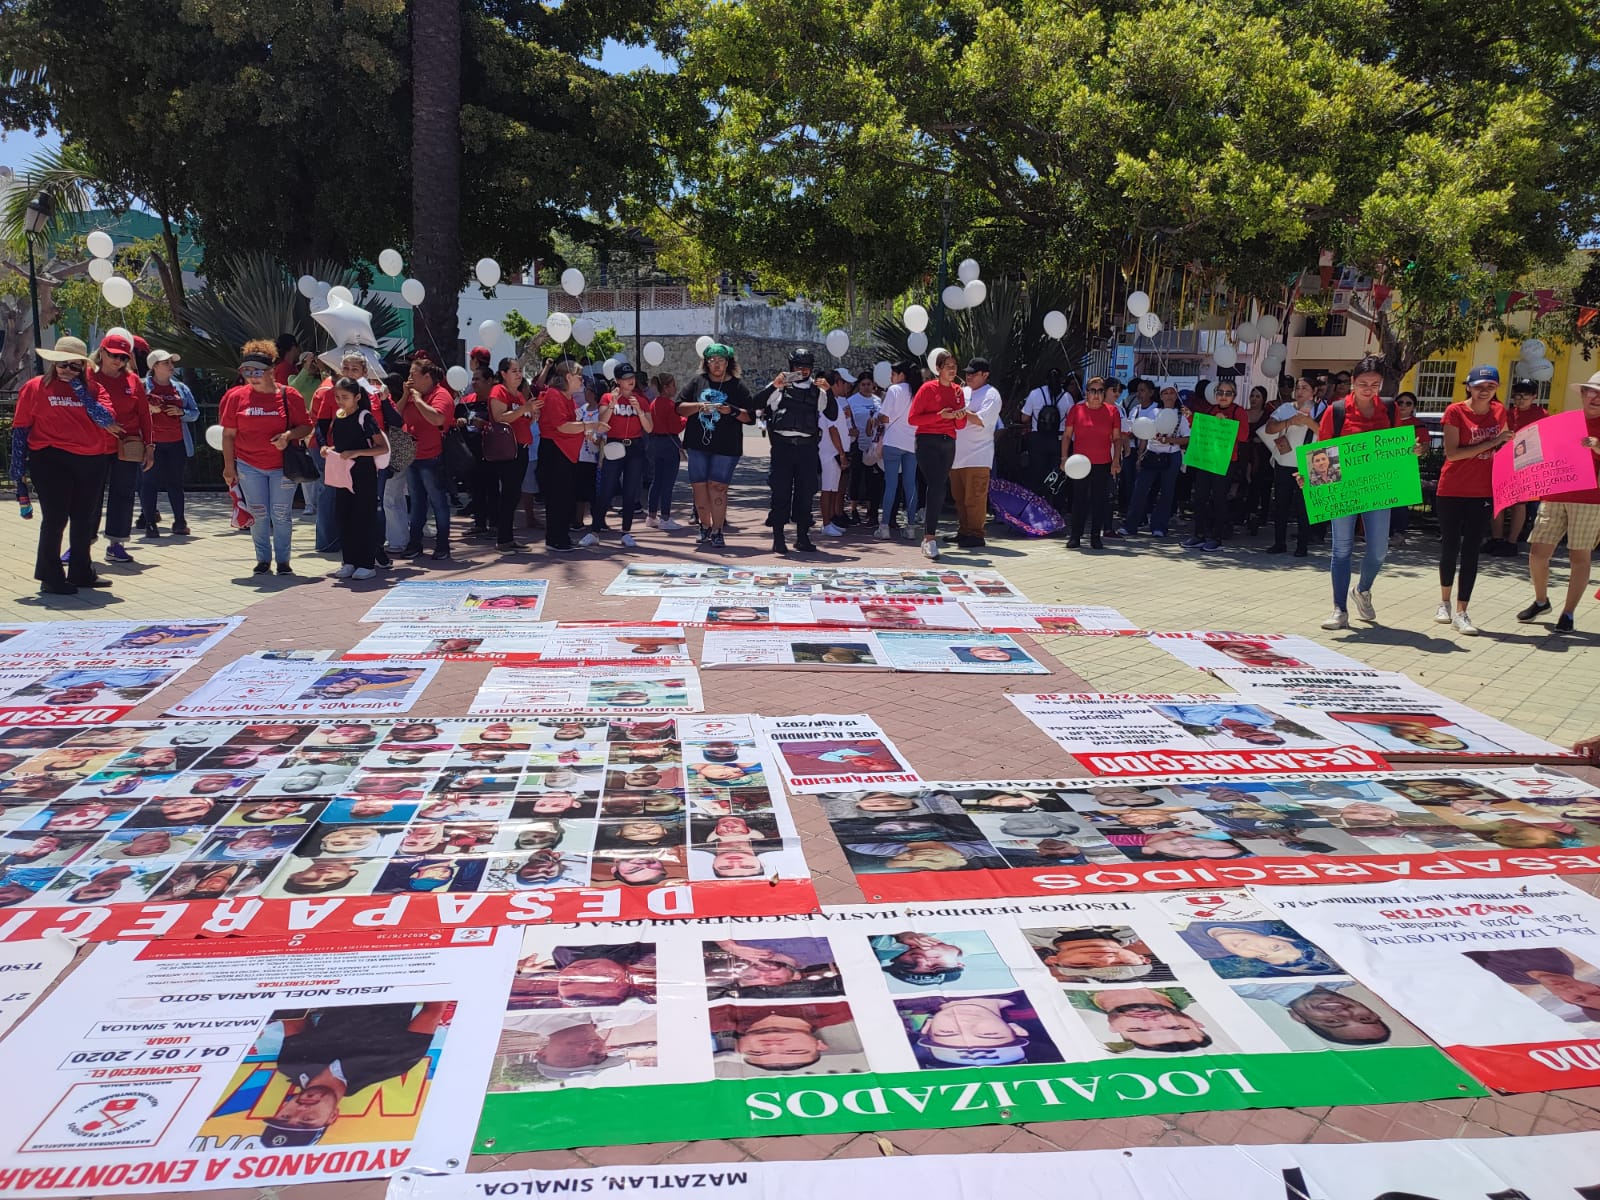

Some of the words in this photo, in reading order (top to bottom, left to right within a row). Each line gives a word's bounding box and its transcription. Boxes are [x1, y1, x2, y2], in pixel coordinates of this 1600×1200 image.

[1342, 442, 1367, 454] JOSE
[1374, 435, 1409, 449] RAMON
[1344, 453, 1370, 467] NIETO
[1534, 473, 1578, 490] BUSCANDO
[1309, 488, 1321, 500] NO
[1312, 494, 1337, 507] HASTA
[1372, 497, 1399, 508] MUCHO
[319, 702, 403, 710] AYUDANOS
[771, 731, 844, 740] ALEJANDRO
[1089, 748, 1377, 773] DESAPARECIDO
[1249, 772, 1381, 782] PERDIDOS
[1389, 768, 1506, 778] TESOROS
[790, 774, 919, 787] DESAPARECIDO
[1155, 775, 1240, 784] HASTA
[904, 905, 1021, 917] PERDIDOS
[1028, 902, 1136, 913] TESOROS
[610, 914, 812, 928] ENCONTRARLOS
[822, 910, 897, 921] HASTA
[1480, 915, 1520, 928] 2020
[1553, 914, 1572, 923] de
[1572, 914, 1588, 922] 2
[1361, 934, 1436, 946] OSUNA
[1436, 928, 1551, 942] LIZARRAGA
[0, 962, 43, 973] TESO
[1, 993, 31, 1001] 27
[159, 994, 212, 1003] SOTO
[217, 991, 277, 1000] MARIA
[283, 988, 330, 998] NOEL
[101, 1023, 168, 1032] SINALOA
[172, 1019, 260, 1030] MAZATLAN,
[144, 1036, 191, 1045] LUGAR:
[71, 1050, 131, 1063] 2020
[133, 1050, 147, 1061] /
[151, 1048, 180, 1060] 05
[184, 1048, 197, 1058] /
[203, 1046, 230, 1058] 04
[745, 1066, 1263, 1120] LOCALIZADOS
[101, 1119, 147, 1138] TESOROS
[204, 1158, 231, 1181] A
[233, 1148, 410, 1180] AYUDANOS
[600, 1171, 747, 1191] MAZATLAN,
[475, 1178, 594, 1197] SINALOA.
